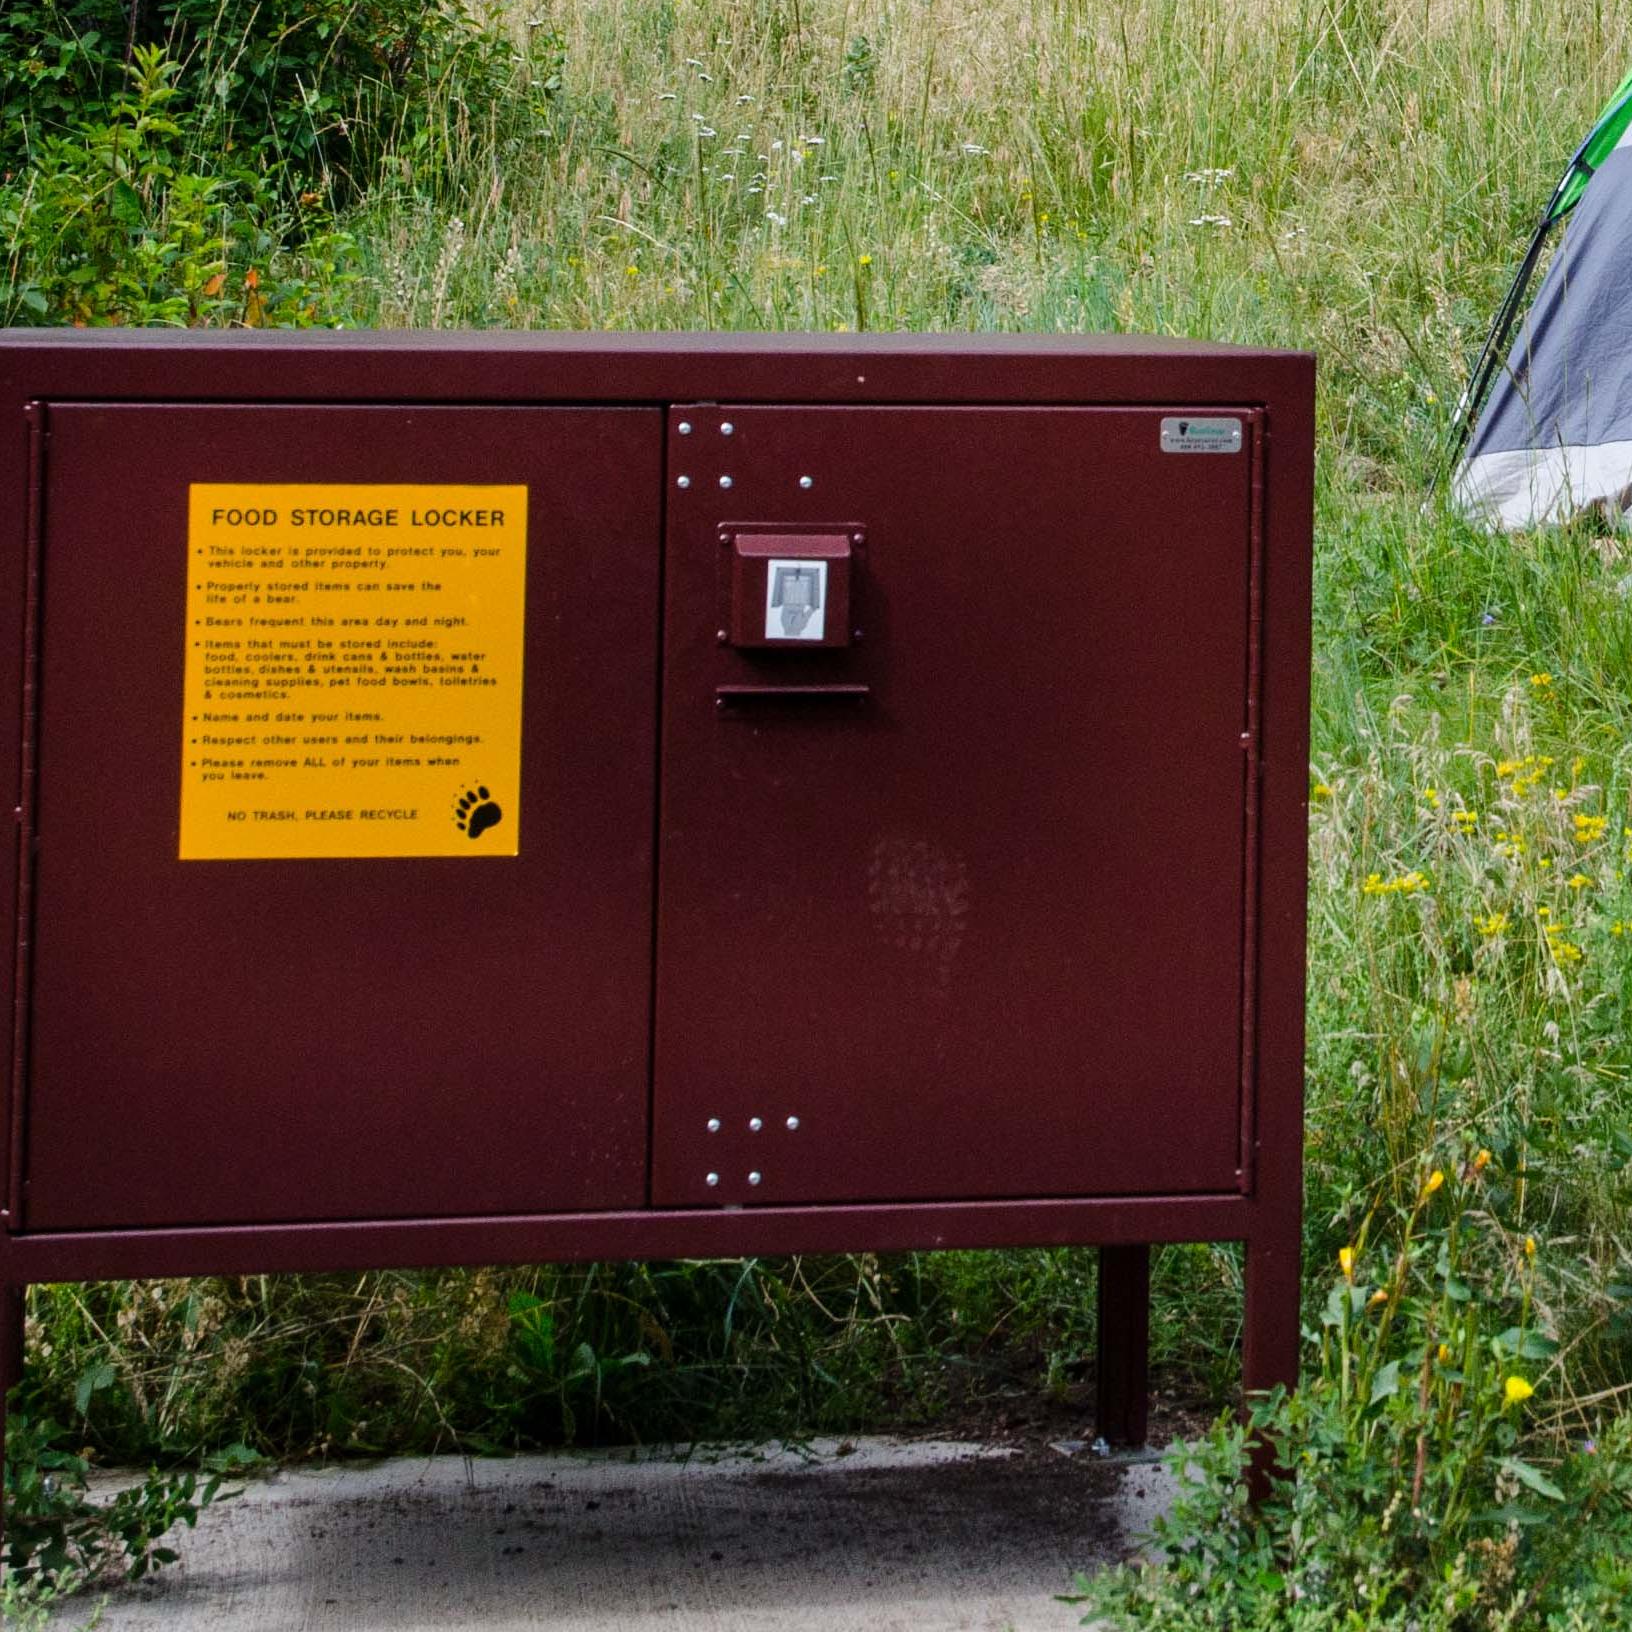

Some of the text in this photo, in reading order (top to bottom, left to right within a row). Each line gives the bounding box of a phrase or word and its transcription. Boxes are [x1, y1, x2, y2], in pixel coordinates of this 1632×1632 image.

[212, 509, 506, 527] FOOD STORAGE LOCKER
[208, 546, 234, 556] This
[241, 546, 283, 556] locker
[288, 546, 299, 556] is
[305, 546, 362, 558] provided
[367, 546, 381, 556] to
[387, 546, 434, 558] protect
[473, 548, 501, 558] your
[207, 559, 253, 568] vehicle
[261, 559, 284, 568] and
[291, 559, 326, 568] other
[206, 581, 442, 594] Properly stored items can save the
[206, 594, 227, 604] life
[233, 594, 246, 604] of
[253, 596, 260, 604] a
[205, 616, 243, 626] Bears
[249, 616, 304, 629] frequent
[311, 616, 334, 626] this
[341, 618, 369, 626] area
[375, 616, 399, 628] day
[404, 616, 428, 626] and
[247, 640, 273, 649] that
[279, 640, 311, 649] must
[317, 640, 333, 649] be
[339, 640, 381, 649] stored
[304, 652, 336, 662] drink
[343, 654, 373, 662] cans
[379, 652, 388, 662] &
[451, 652, 486, 662] water
[258, 665, 301, 674] dishes
[307, 665, 316, 674] &
[385, 665, 417, 674] wash
[423, 665, 465, 674] basins
[471, 665, 479, 674] &
[203, 677, 260, 689] cleaning
[329, 677, 350, 689] pet
[357, 677, 387, 687] food
[203, 690, 213, 700] &
[203, 712, 239, 722] Name
[246, 712, 270, 722] and
[275, 712, 304, 722] date
[311, 714, 340, 724] your
[202, 735, 256, 747] Respect
[262, 735, 296, 745] other
[302, 737, 338, 745] users
[345, 735, 369, 744] and
[375, 735, 404, 744] their
[201, 757, 460, 769] Please remove ALL of your items when
[201, 773, 225, 783] you
[226, 810, 247, 821] NO
[304, 810, 354, 821] PLEASE
[359, 809, 418, 820] RECYCLE
